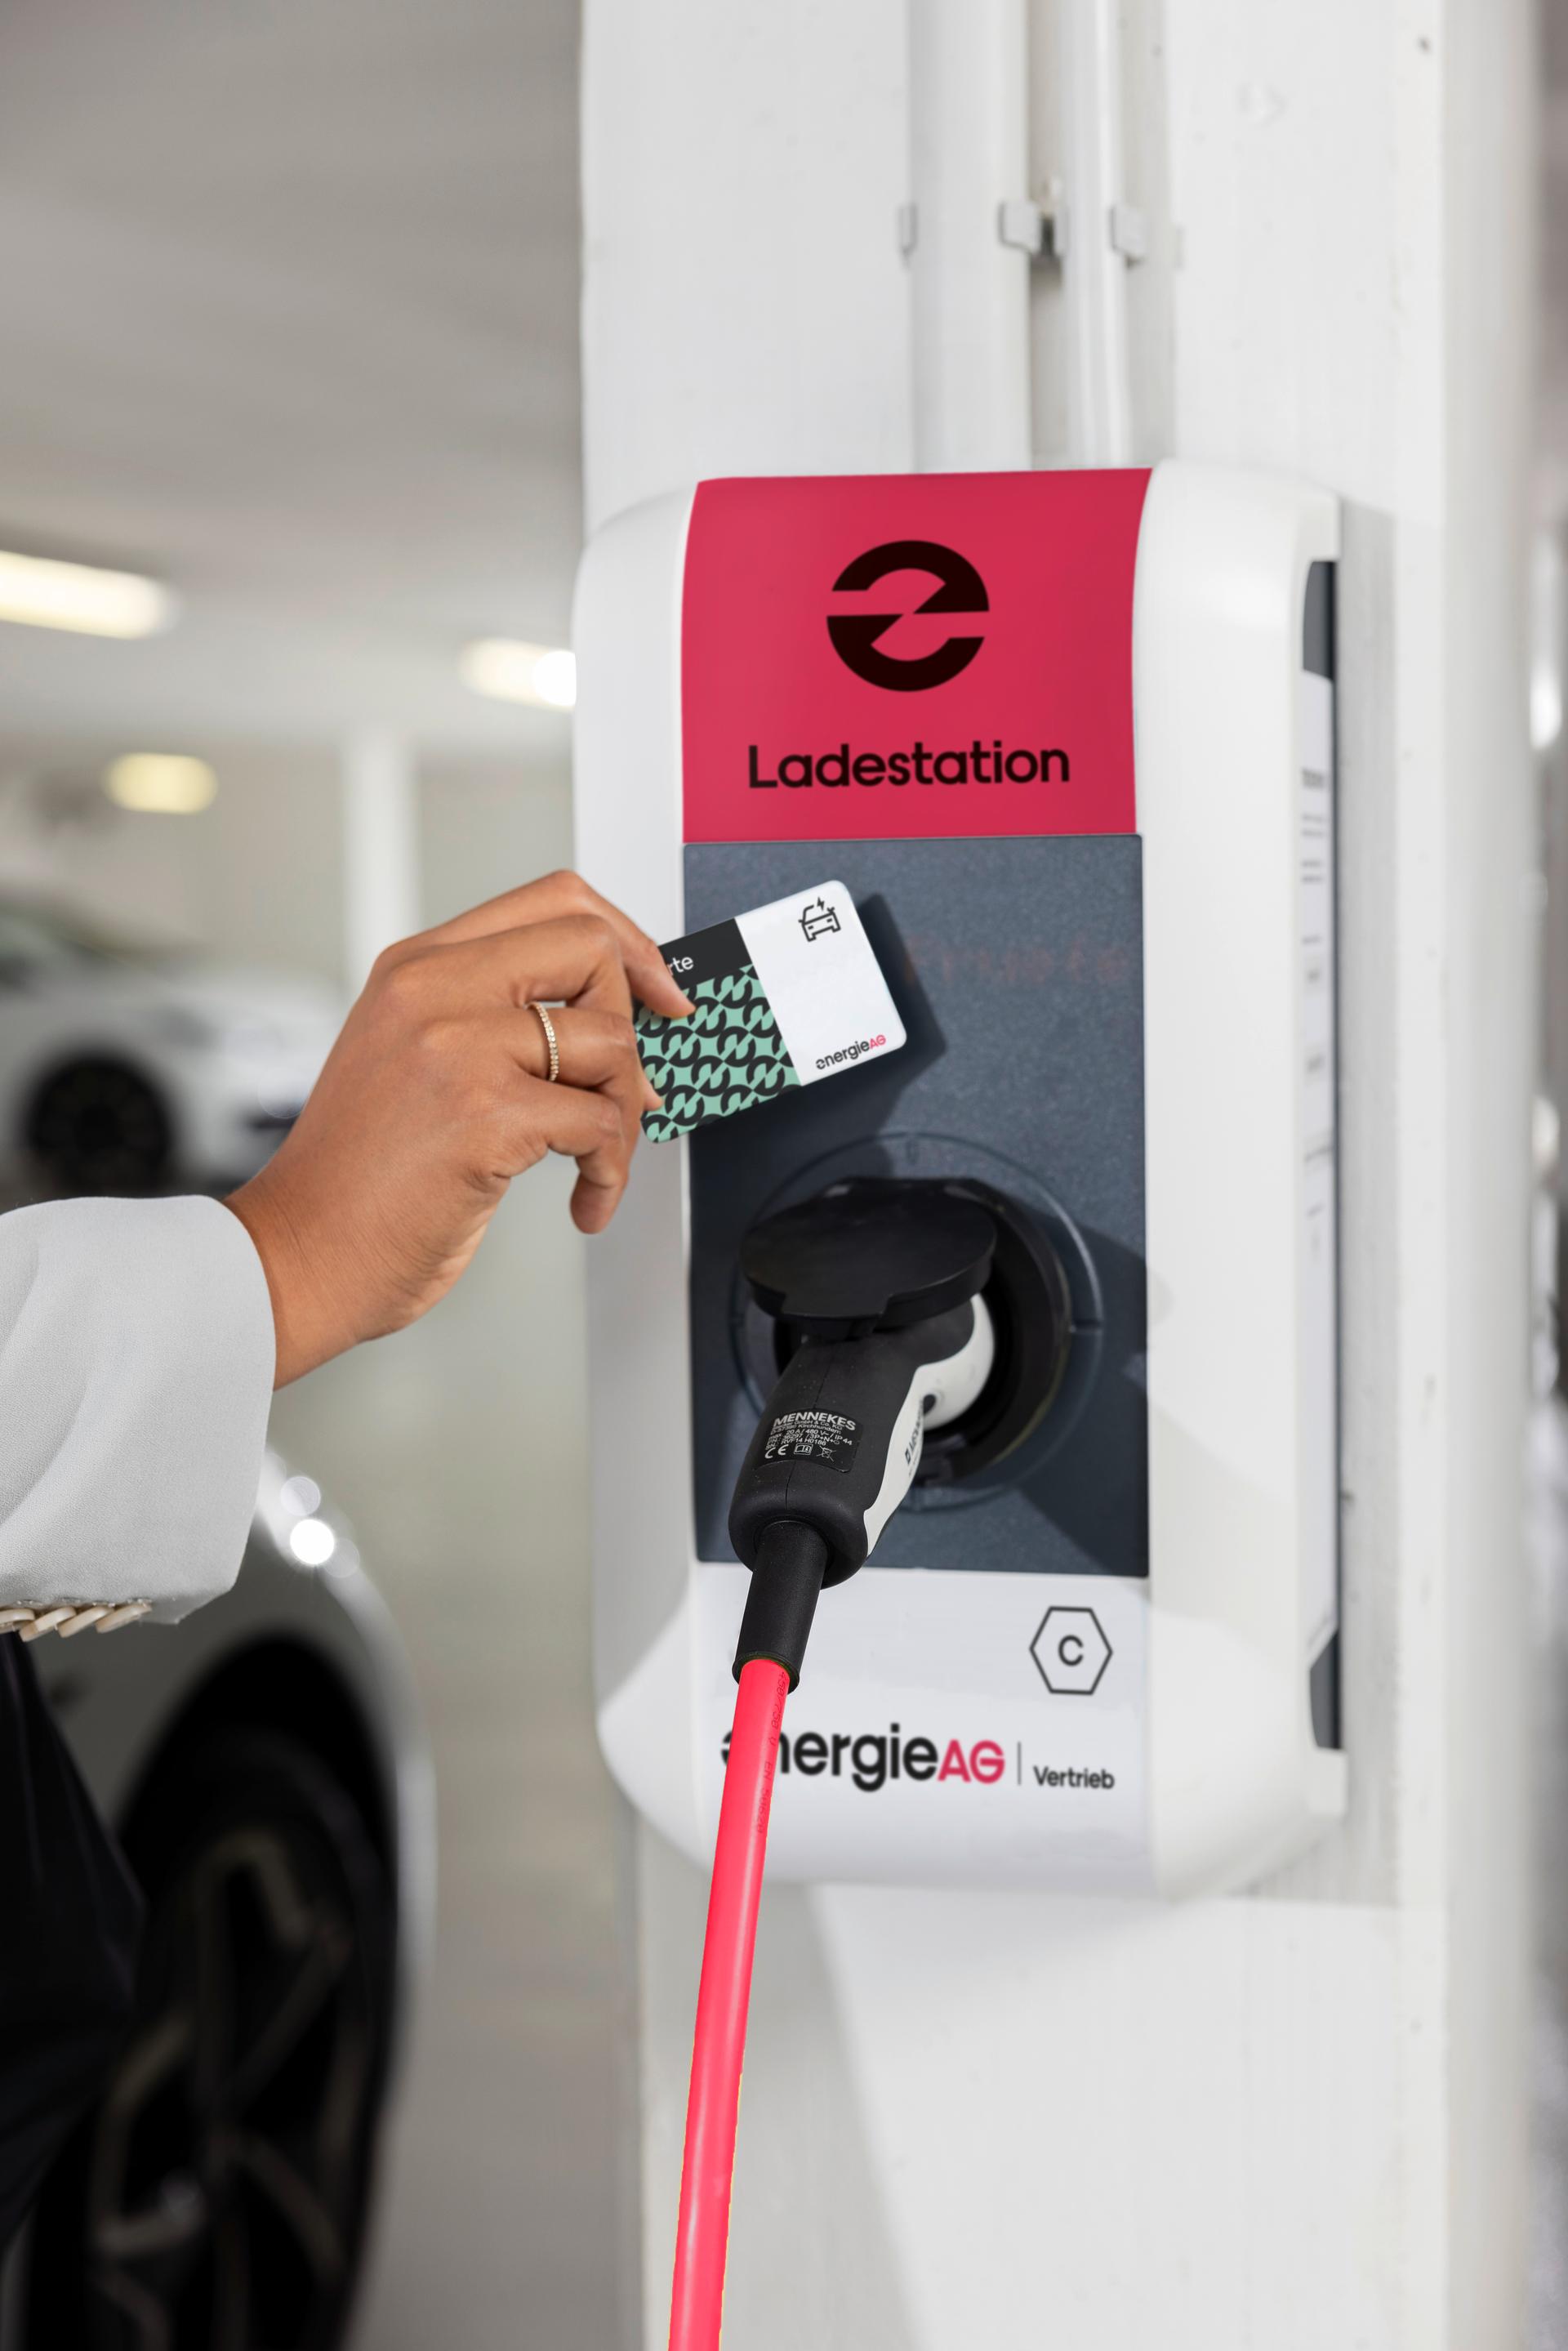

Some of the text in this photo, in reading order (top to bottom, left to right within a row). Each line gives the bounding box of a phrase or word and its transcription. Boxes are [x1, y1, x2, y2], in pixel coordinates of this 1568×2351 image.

[748, 740, 1070, 788] Ladestation
[815, 1034, 887, 1070] energieAG
[773, 1412, 857, 1430] MENNEKES
[834, 1434, 843, 1442] IP
[842, 1437, 853, 1446] 44
[1032, 1765, 1116, 1790] Vertrieb
